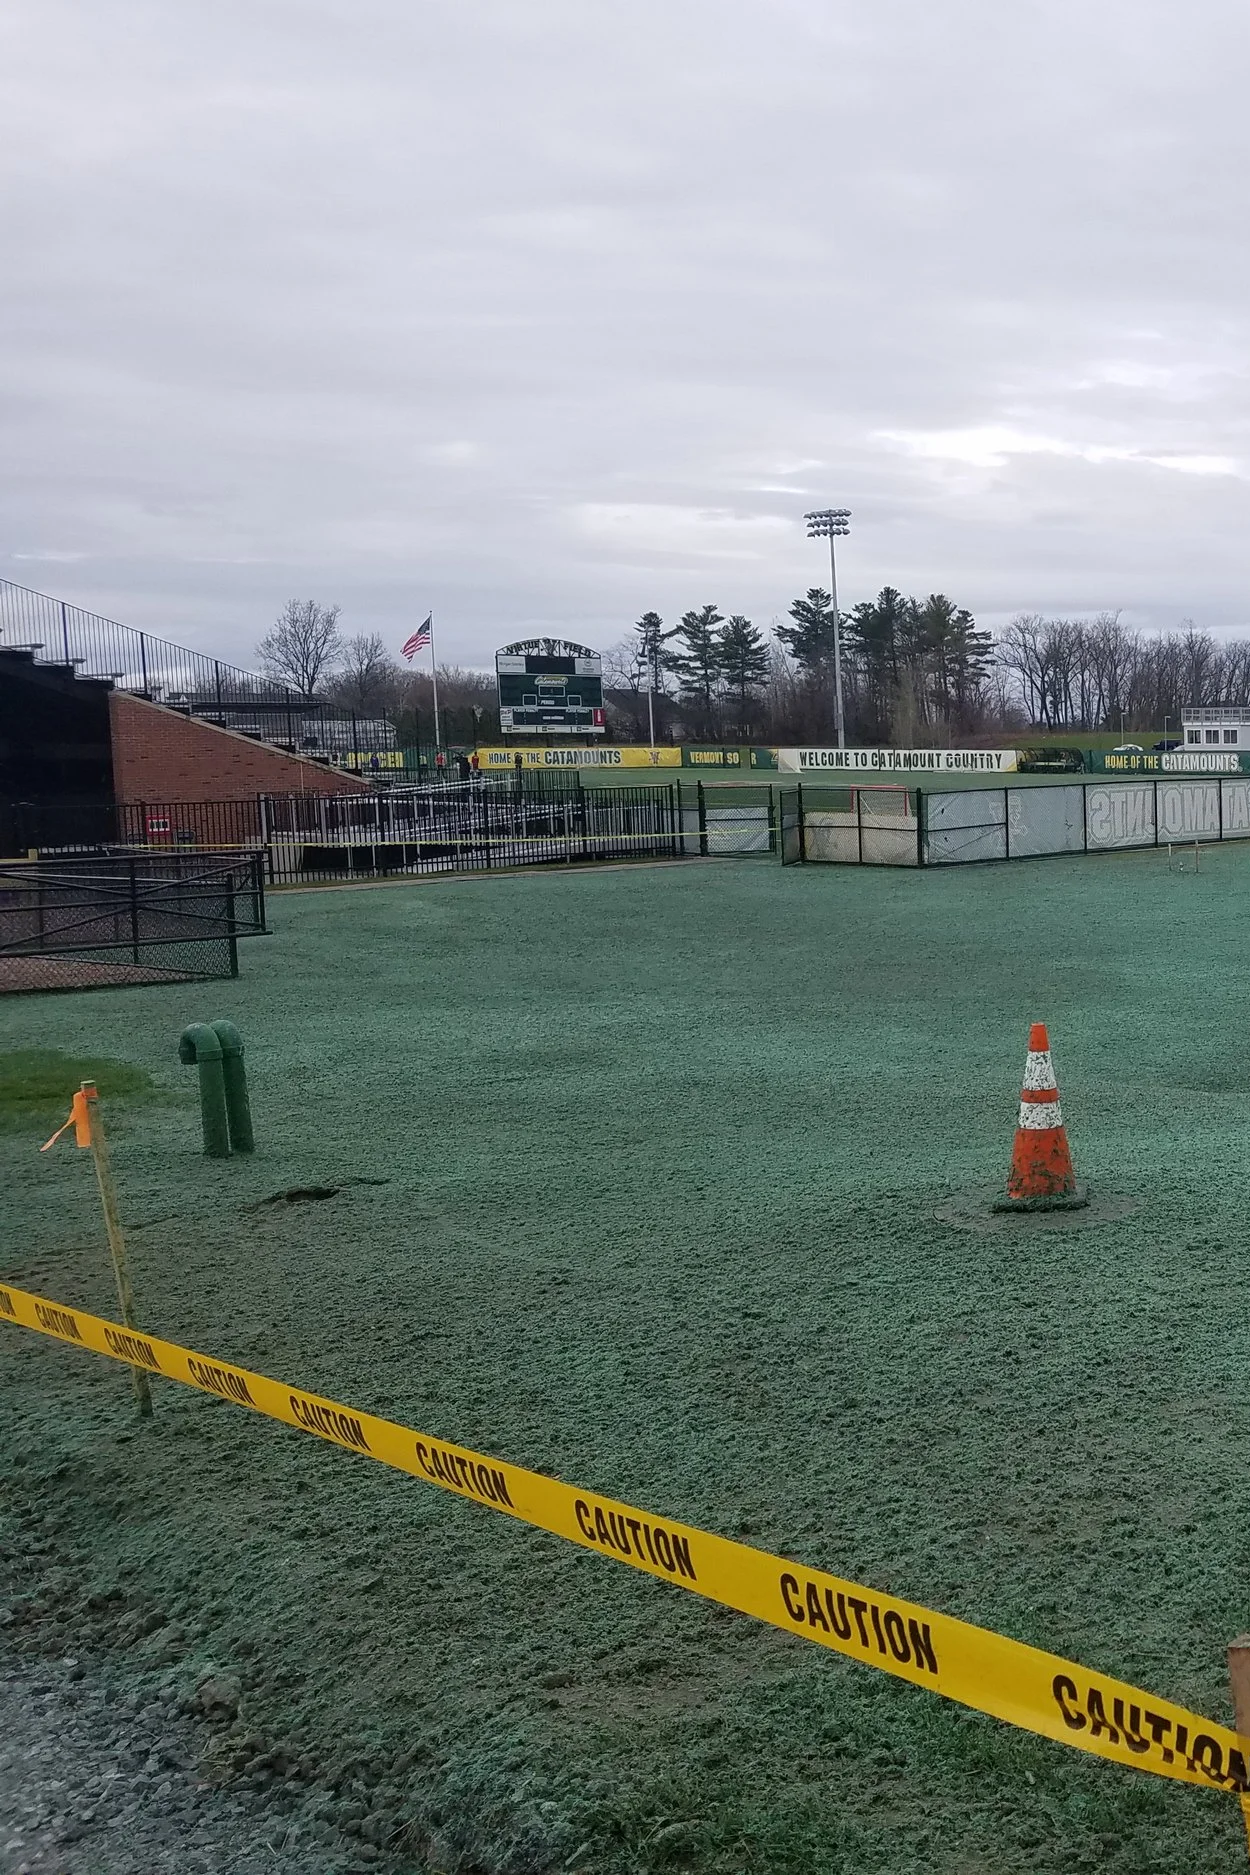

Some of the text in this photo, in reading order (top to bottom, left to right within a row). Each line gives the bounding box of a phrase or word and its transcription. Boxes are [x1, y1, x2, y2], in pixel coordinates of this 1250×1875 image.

[489, 751, 512, 764] HOME
[526, 751, 541, 764] THE
[544, 750, 621, 766] CATAMOUNTS
[690, 751, 724, 764] VERMONT
[800, 751, 1002, 768] WELCOME TO CATAMOUNT COUNTRY
[1105, 753, 1240, 772] HOME OF THE CATAMOUNTS
[34, 1302, 83, 1341] CAUTION
[103, 1327, 162, 1371] CAUTION
[187, 1356, 256, 1407] CAUTION
[289, 1395, 371, 1452] CAUTION
[415, 1441, 515, 1509] CAUTION
[574, 1499, 698, 1580] CAUTION
[779, 1572, 939, 1675] CAUTION
